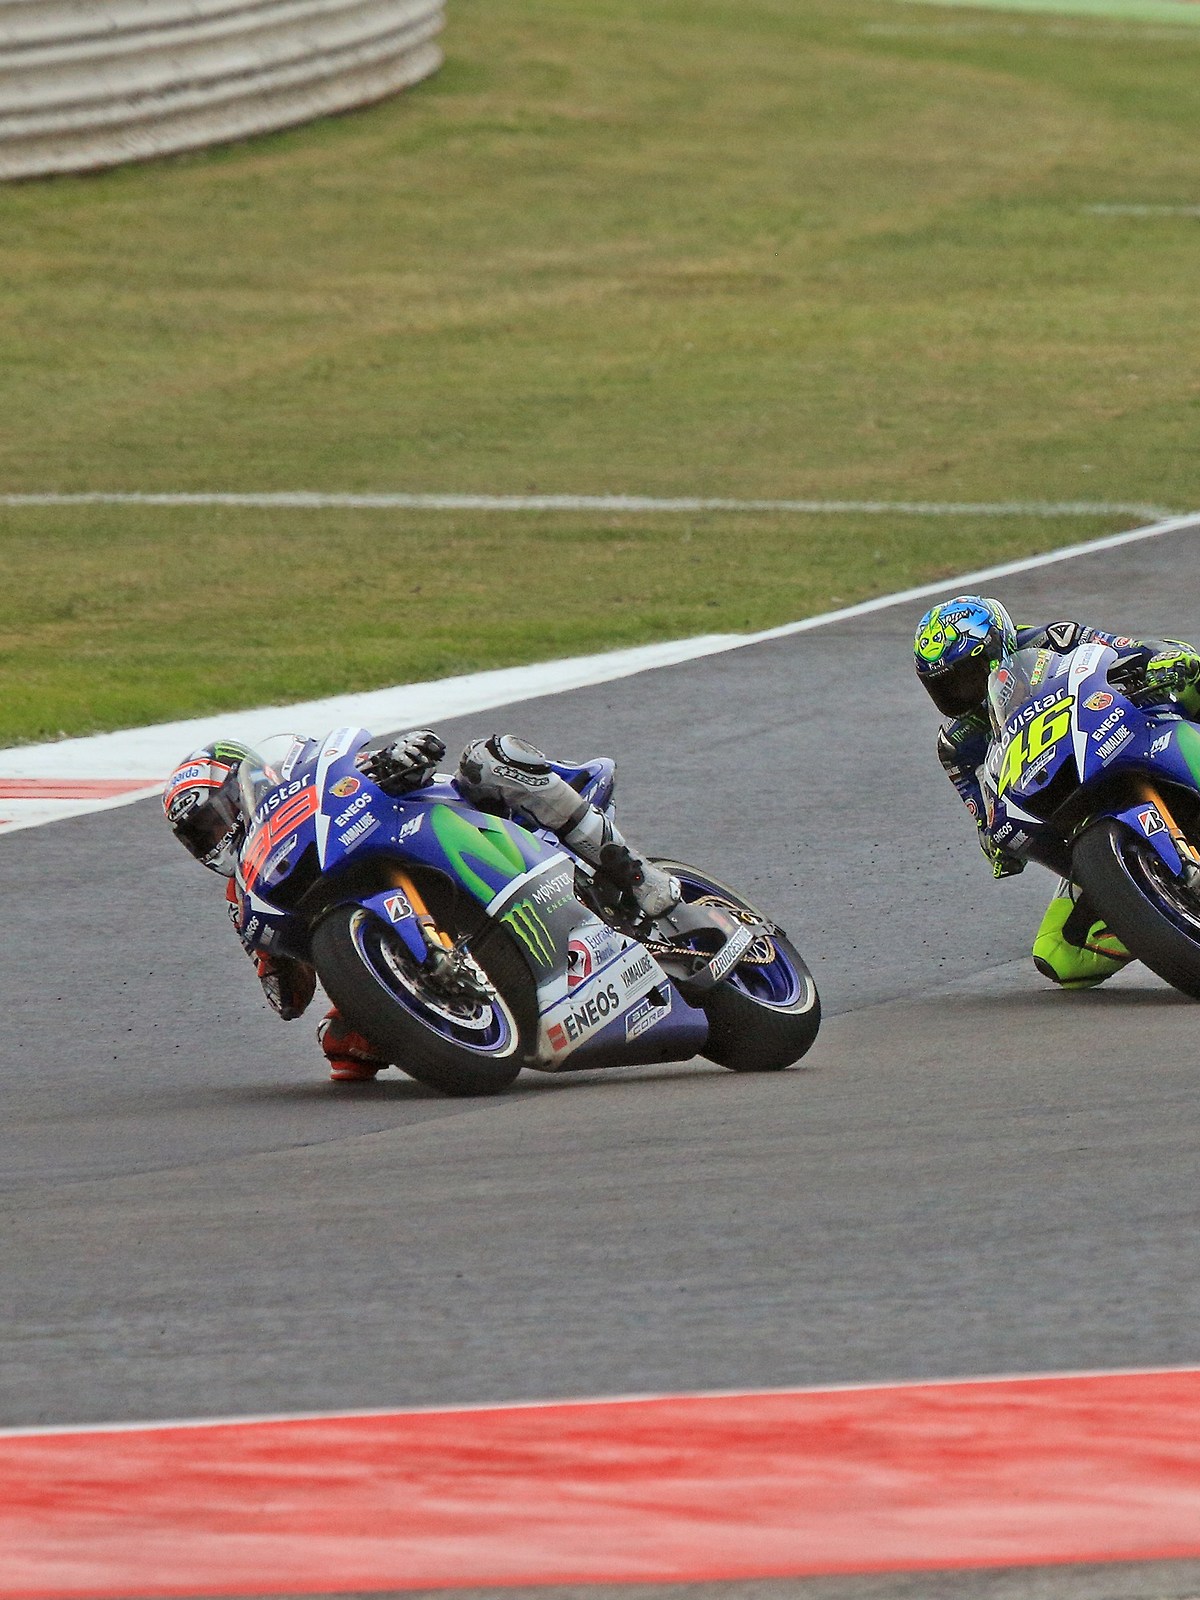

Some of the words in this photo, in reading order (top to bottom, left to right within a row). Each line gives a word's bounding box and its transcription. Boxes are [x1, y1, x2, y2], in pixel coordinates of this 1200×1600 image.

[991, 687, 1066, 771] movistar
[1091, 707, 1125, 742] ENEOS
[1095, 724, 1131, 759] YAMALUBE
[998, 696, 1075, 798] 46
[334, 792, 373, 827] ENEOS
[243, 784, 320, 893] 99
[338, 811, 376, 847] YAMALUBE
[532, 872, 574, 905] MONSTER
[563, 983, 620, 1043] ENEOS
